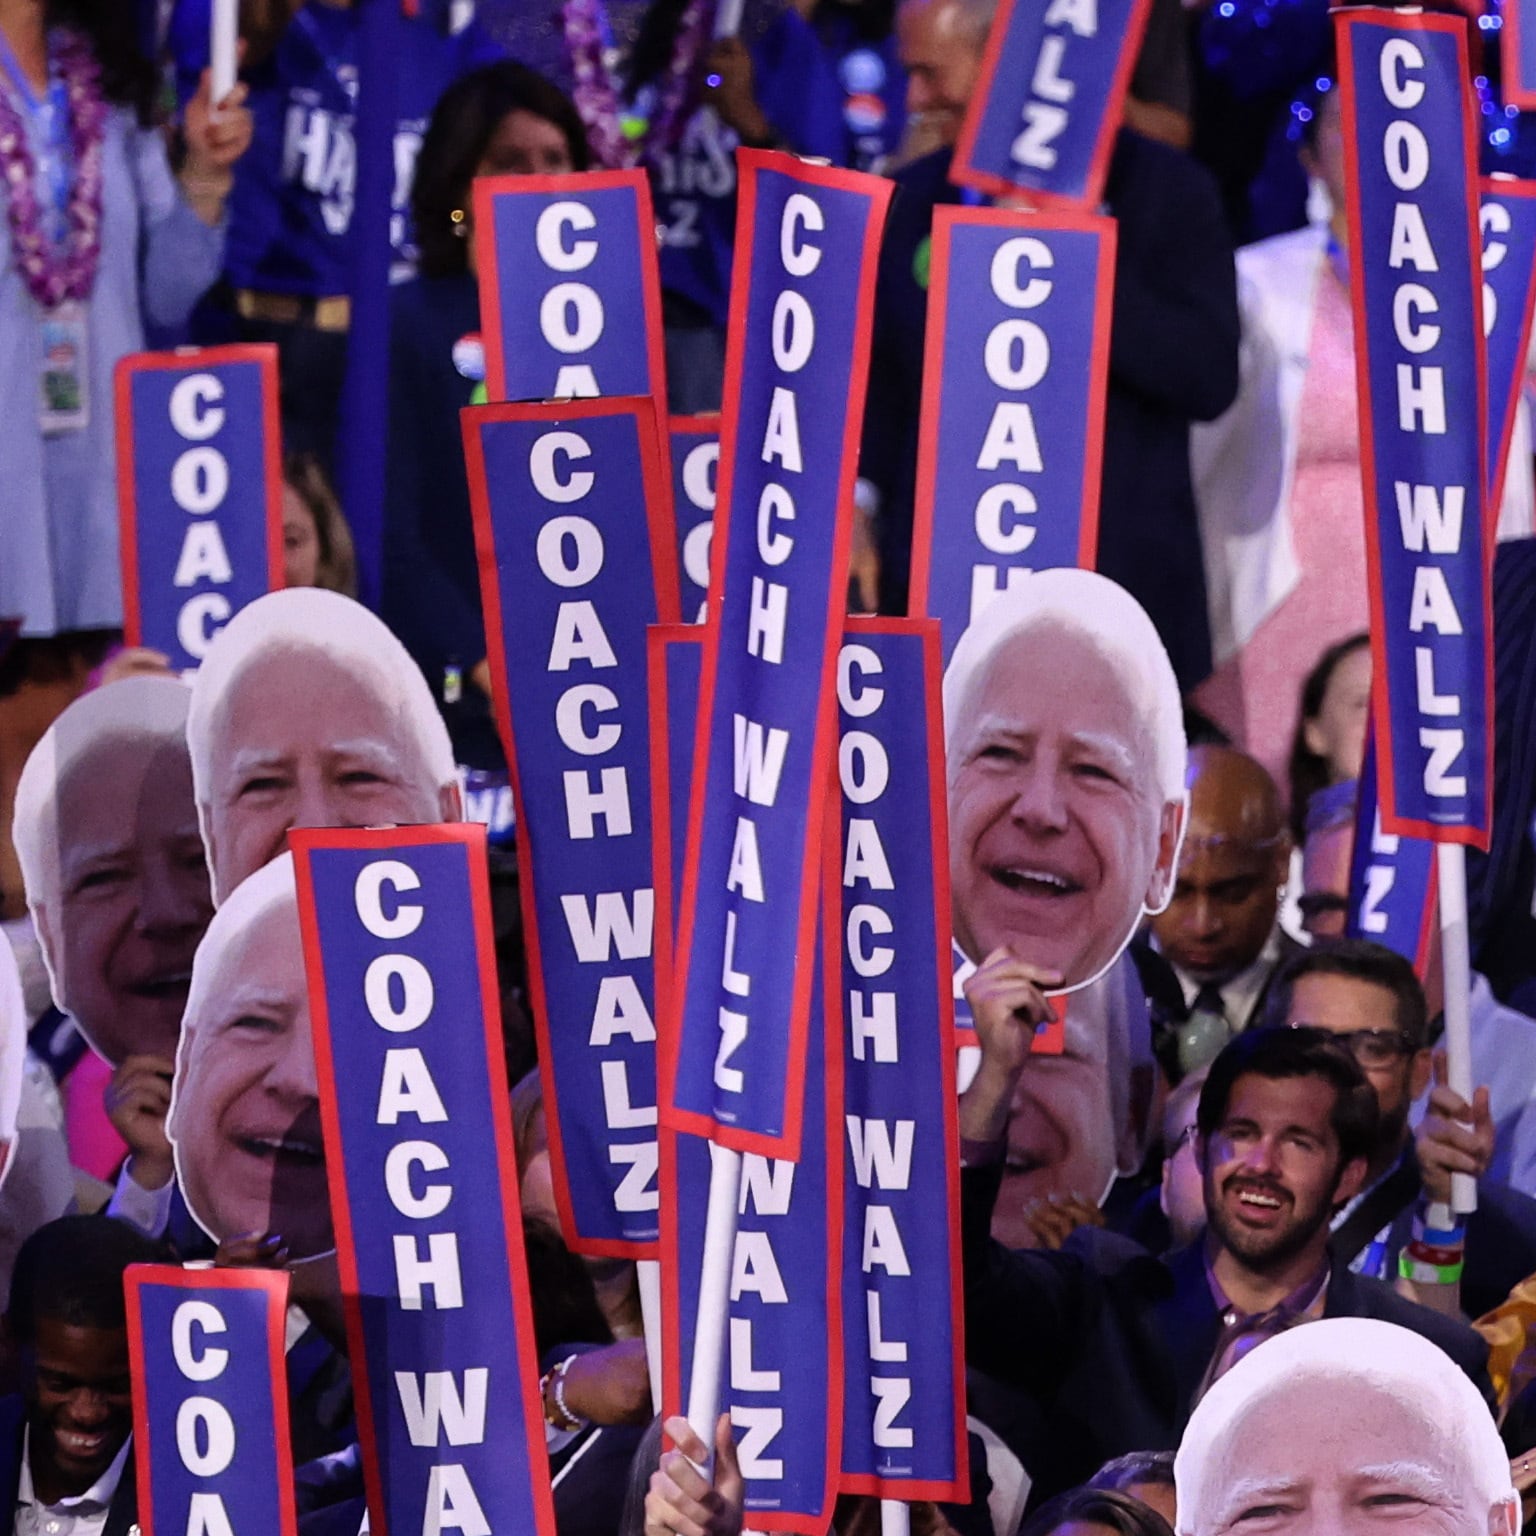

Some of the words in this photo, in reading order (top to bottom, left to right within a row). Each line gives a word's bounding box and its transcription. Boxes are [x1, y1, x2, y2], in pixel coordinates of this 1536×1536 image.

[748, 193, 824, 665] COACH
[1380, 38, 1446, 435] COACH
[530, 431, 632, 840] COACH
[1395, 482, 1468, 796] WALZ
[561, 888, 659, 1212] WALZ
[713, 714, 789, 1093] WALZ
[837, 644, 898, 1064] COACH
[354, 860, 464, 1311] COACH
[846, 1114, 914, 1449] WALZ
